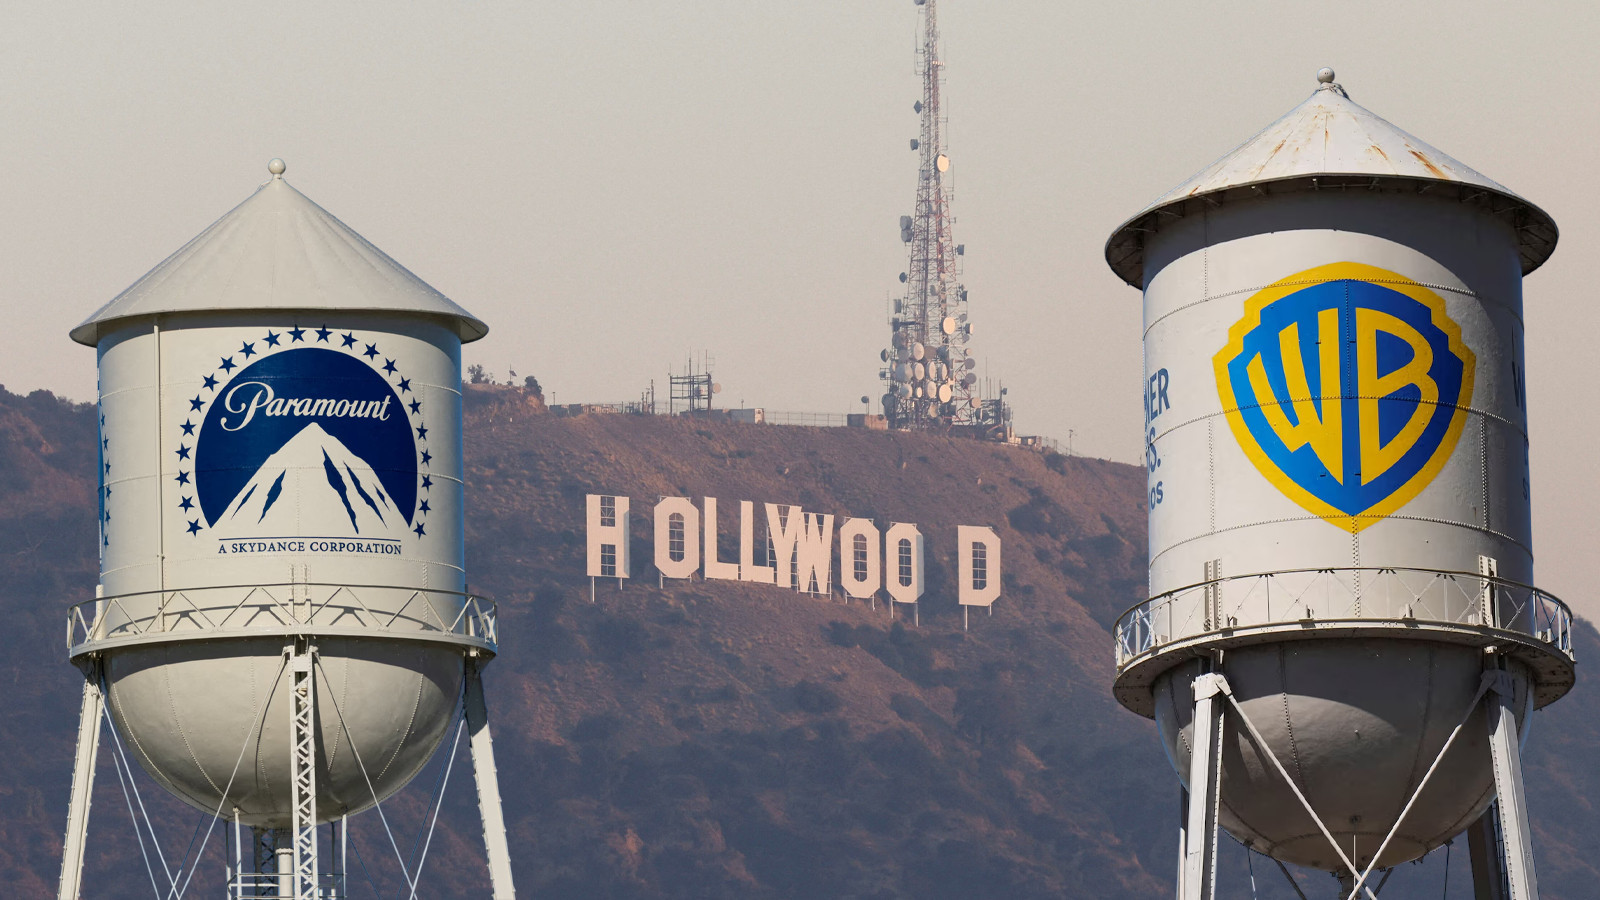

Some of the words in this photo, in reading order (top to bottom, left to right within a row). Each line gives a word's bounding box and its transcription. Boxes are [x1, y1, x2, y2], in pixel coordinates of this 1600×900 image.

[220, 381, 391, 432] Paramount
[1246, 307, 1439, 486] WB
[218, 543, 228, 554] A
[231, 541, 306, 553] SKYDANCE
[310, 541, 402, 555] CORPORATION
[586, 494, 1001, 607] HOLLYWOOD
